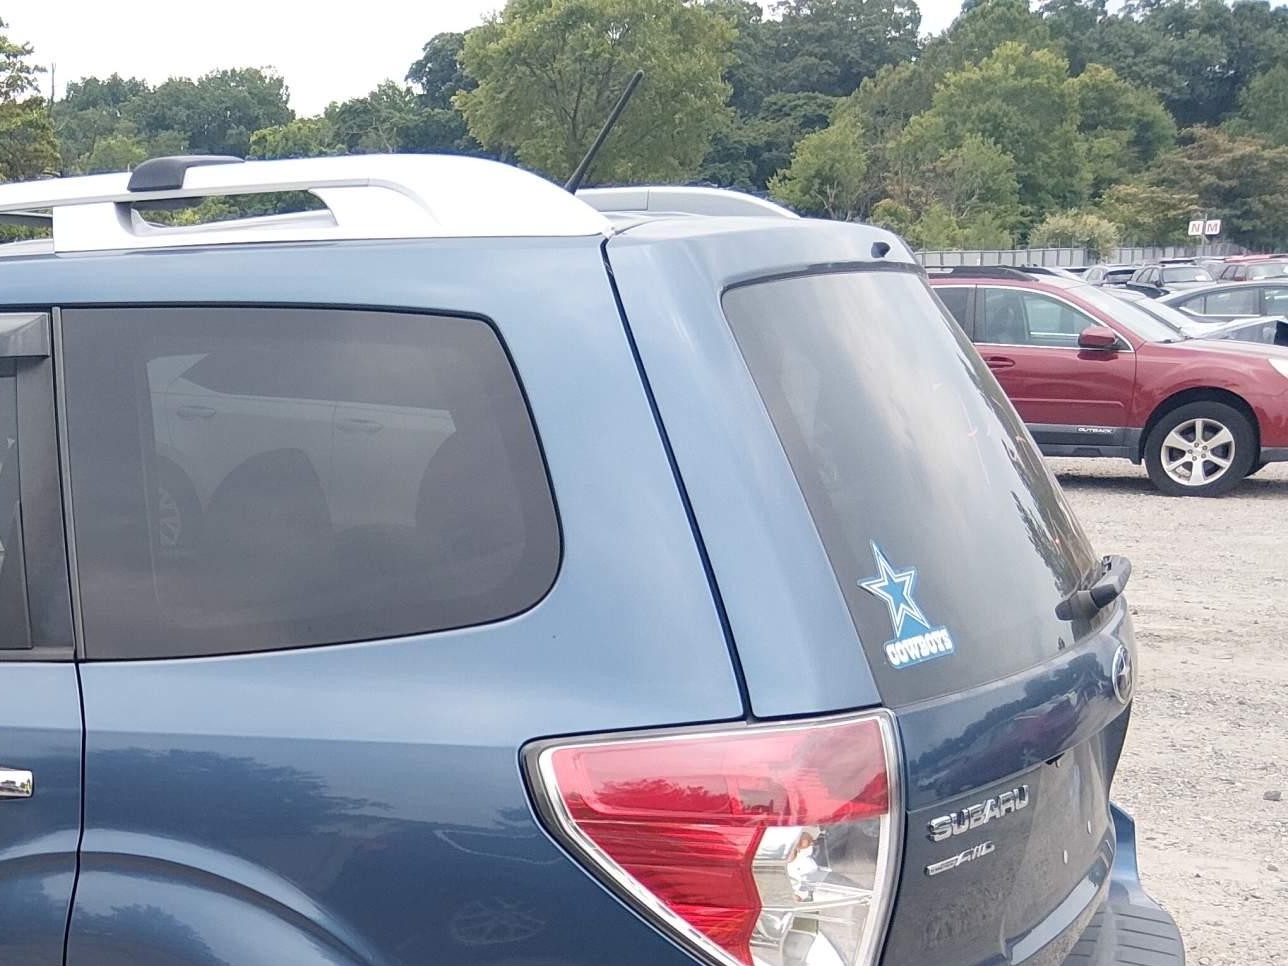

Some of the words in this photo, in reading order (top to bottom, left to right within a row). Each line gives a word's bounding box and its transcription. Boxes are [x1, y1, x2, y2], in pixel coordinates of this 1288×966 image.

[1192, 223, 1201, 233] N
[1207, 223, 1218, 233] M
[885, 628, 953, 666] COWBOYS
[927, 784, 1029, 841] SUBARU
